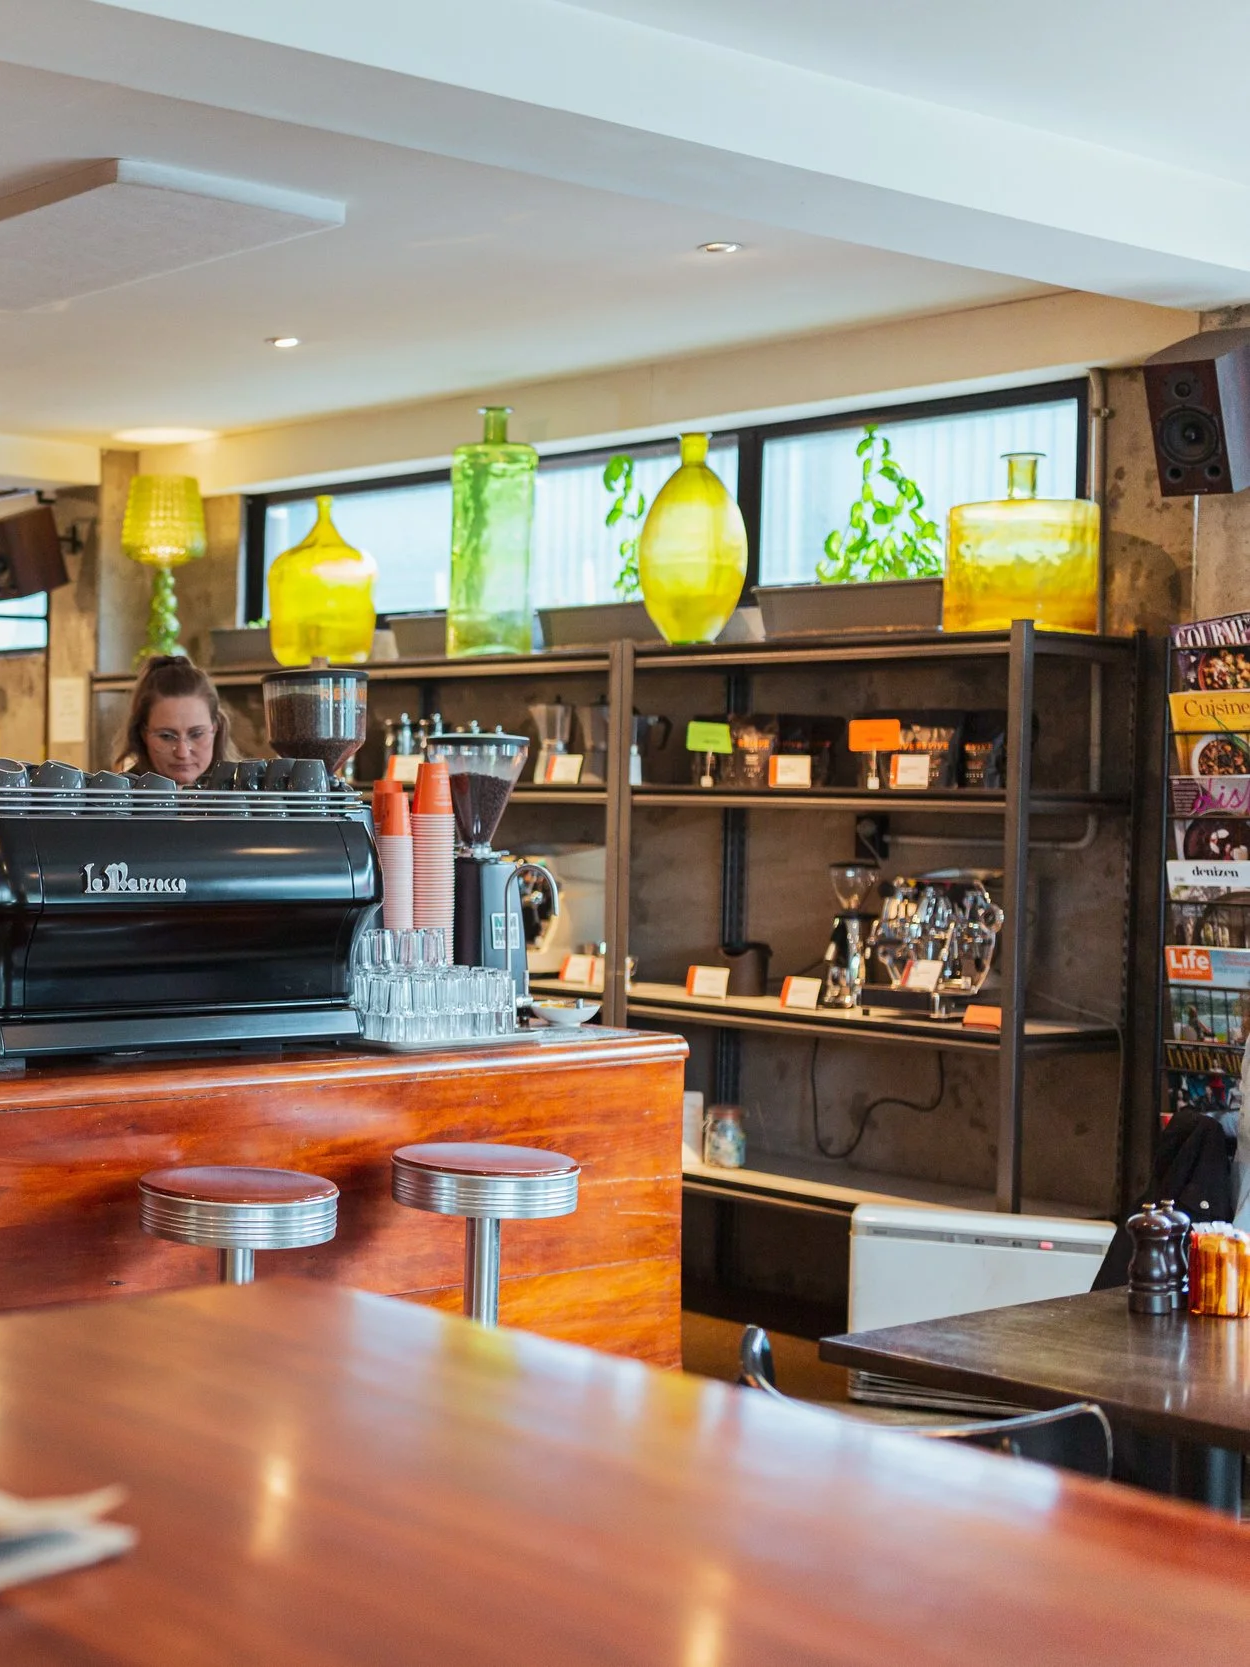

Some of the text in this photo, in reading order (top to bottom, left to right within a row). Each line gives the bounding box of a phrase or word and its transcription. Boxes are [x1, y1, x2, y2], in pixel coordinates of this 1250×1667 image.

[1184, 698, 1250, 718] Cuisine
[104, 862, 187, 893] Marzocco
[1192, 866, 1239, 878] denizen
[1170, 949, 1209, 970] Life
